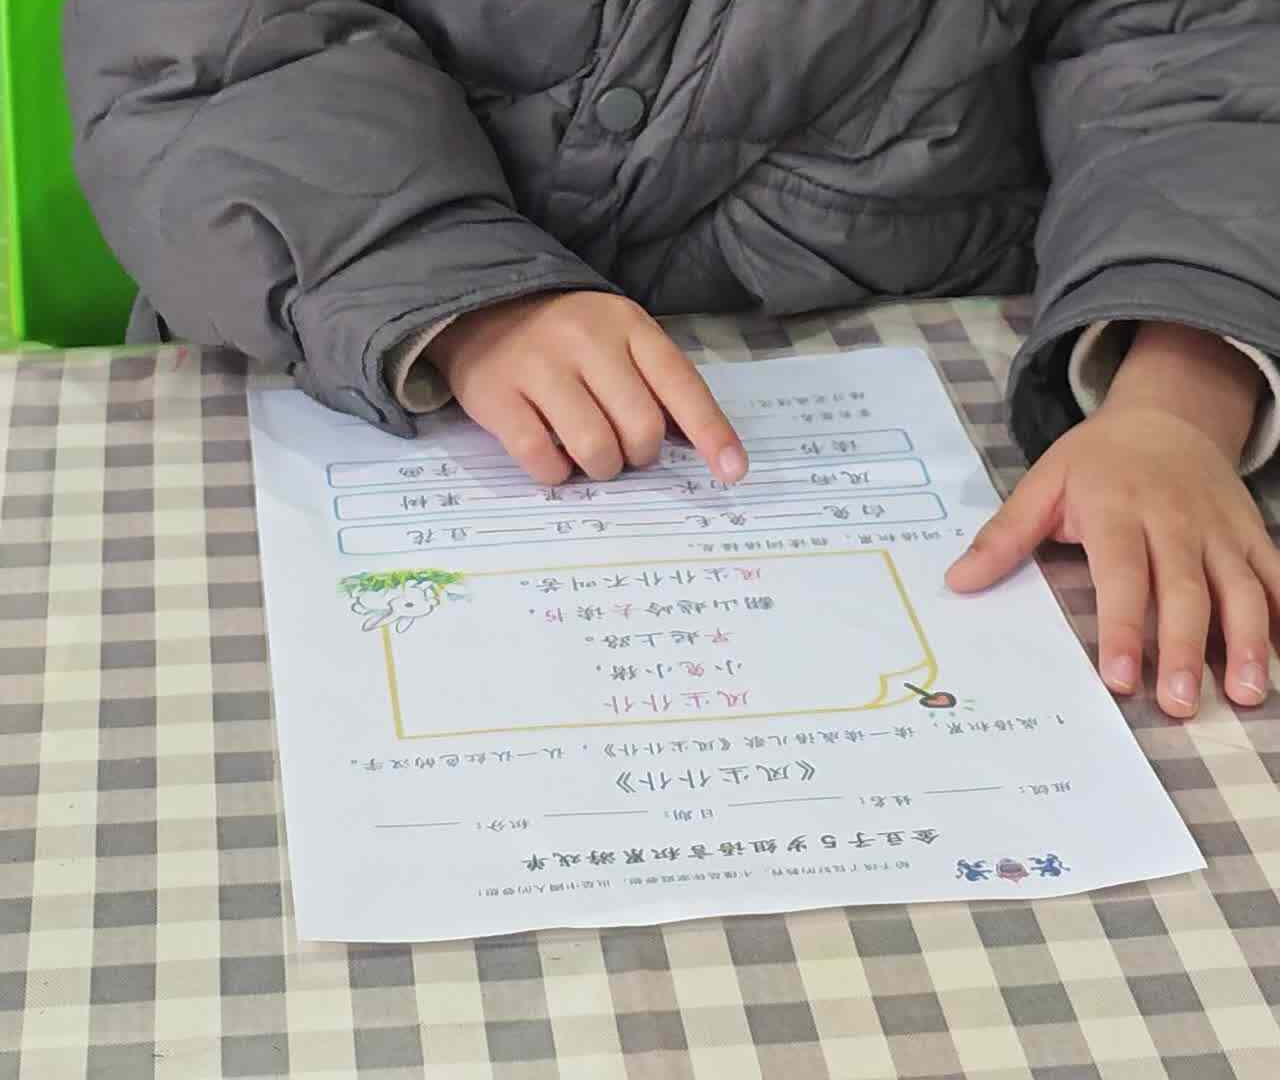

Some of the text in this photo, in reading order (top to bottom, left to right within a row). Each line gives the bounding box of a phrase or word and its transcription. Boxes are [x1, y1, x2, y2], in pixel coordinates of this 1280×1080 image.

[602, 690, 751, 715] 风尘仆仆
[615, 761, 816, 794] 《风尘仆仆》
